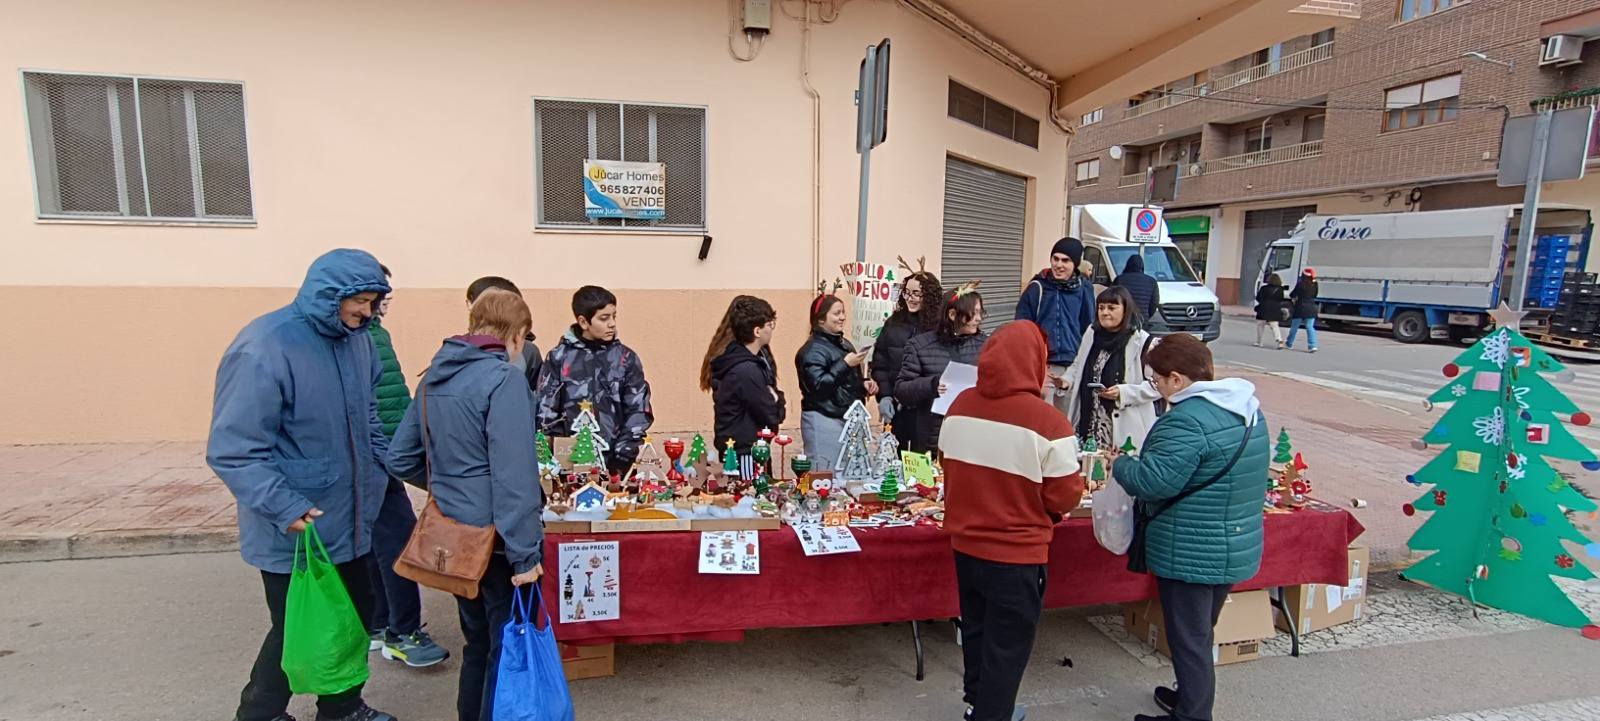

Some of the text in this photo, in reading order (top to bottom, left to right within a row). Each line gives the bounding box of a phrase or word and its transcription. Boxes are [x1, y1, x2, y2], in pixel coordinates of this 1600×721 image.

[627, 171, 665, 182] Homes
[600, 184, 664, 195] 965827406
[622, 197, 664, 207] VENDE
[1318, 217, 1371, 240] Enzo
